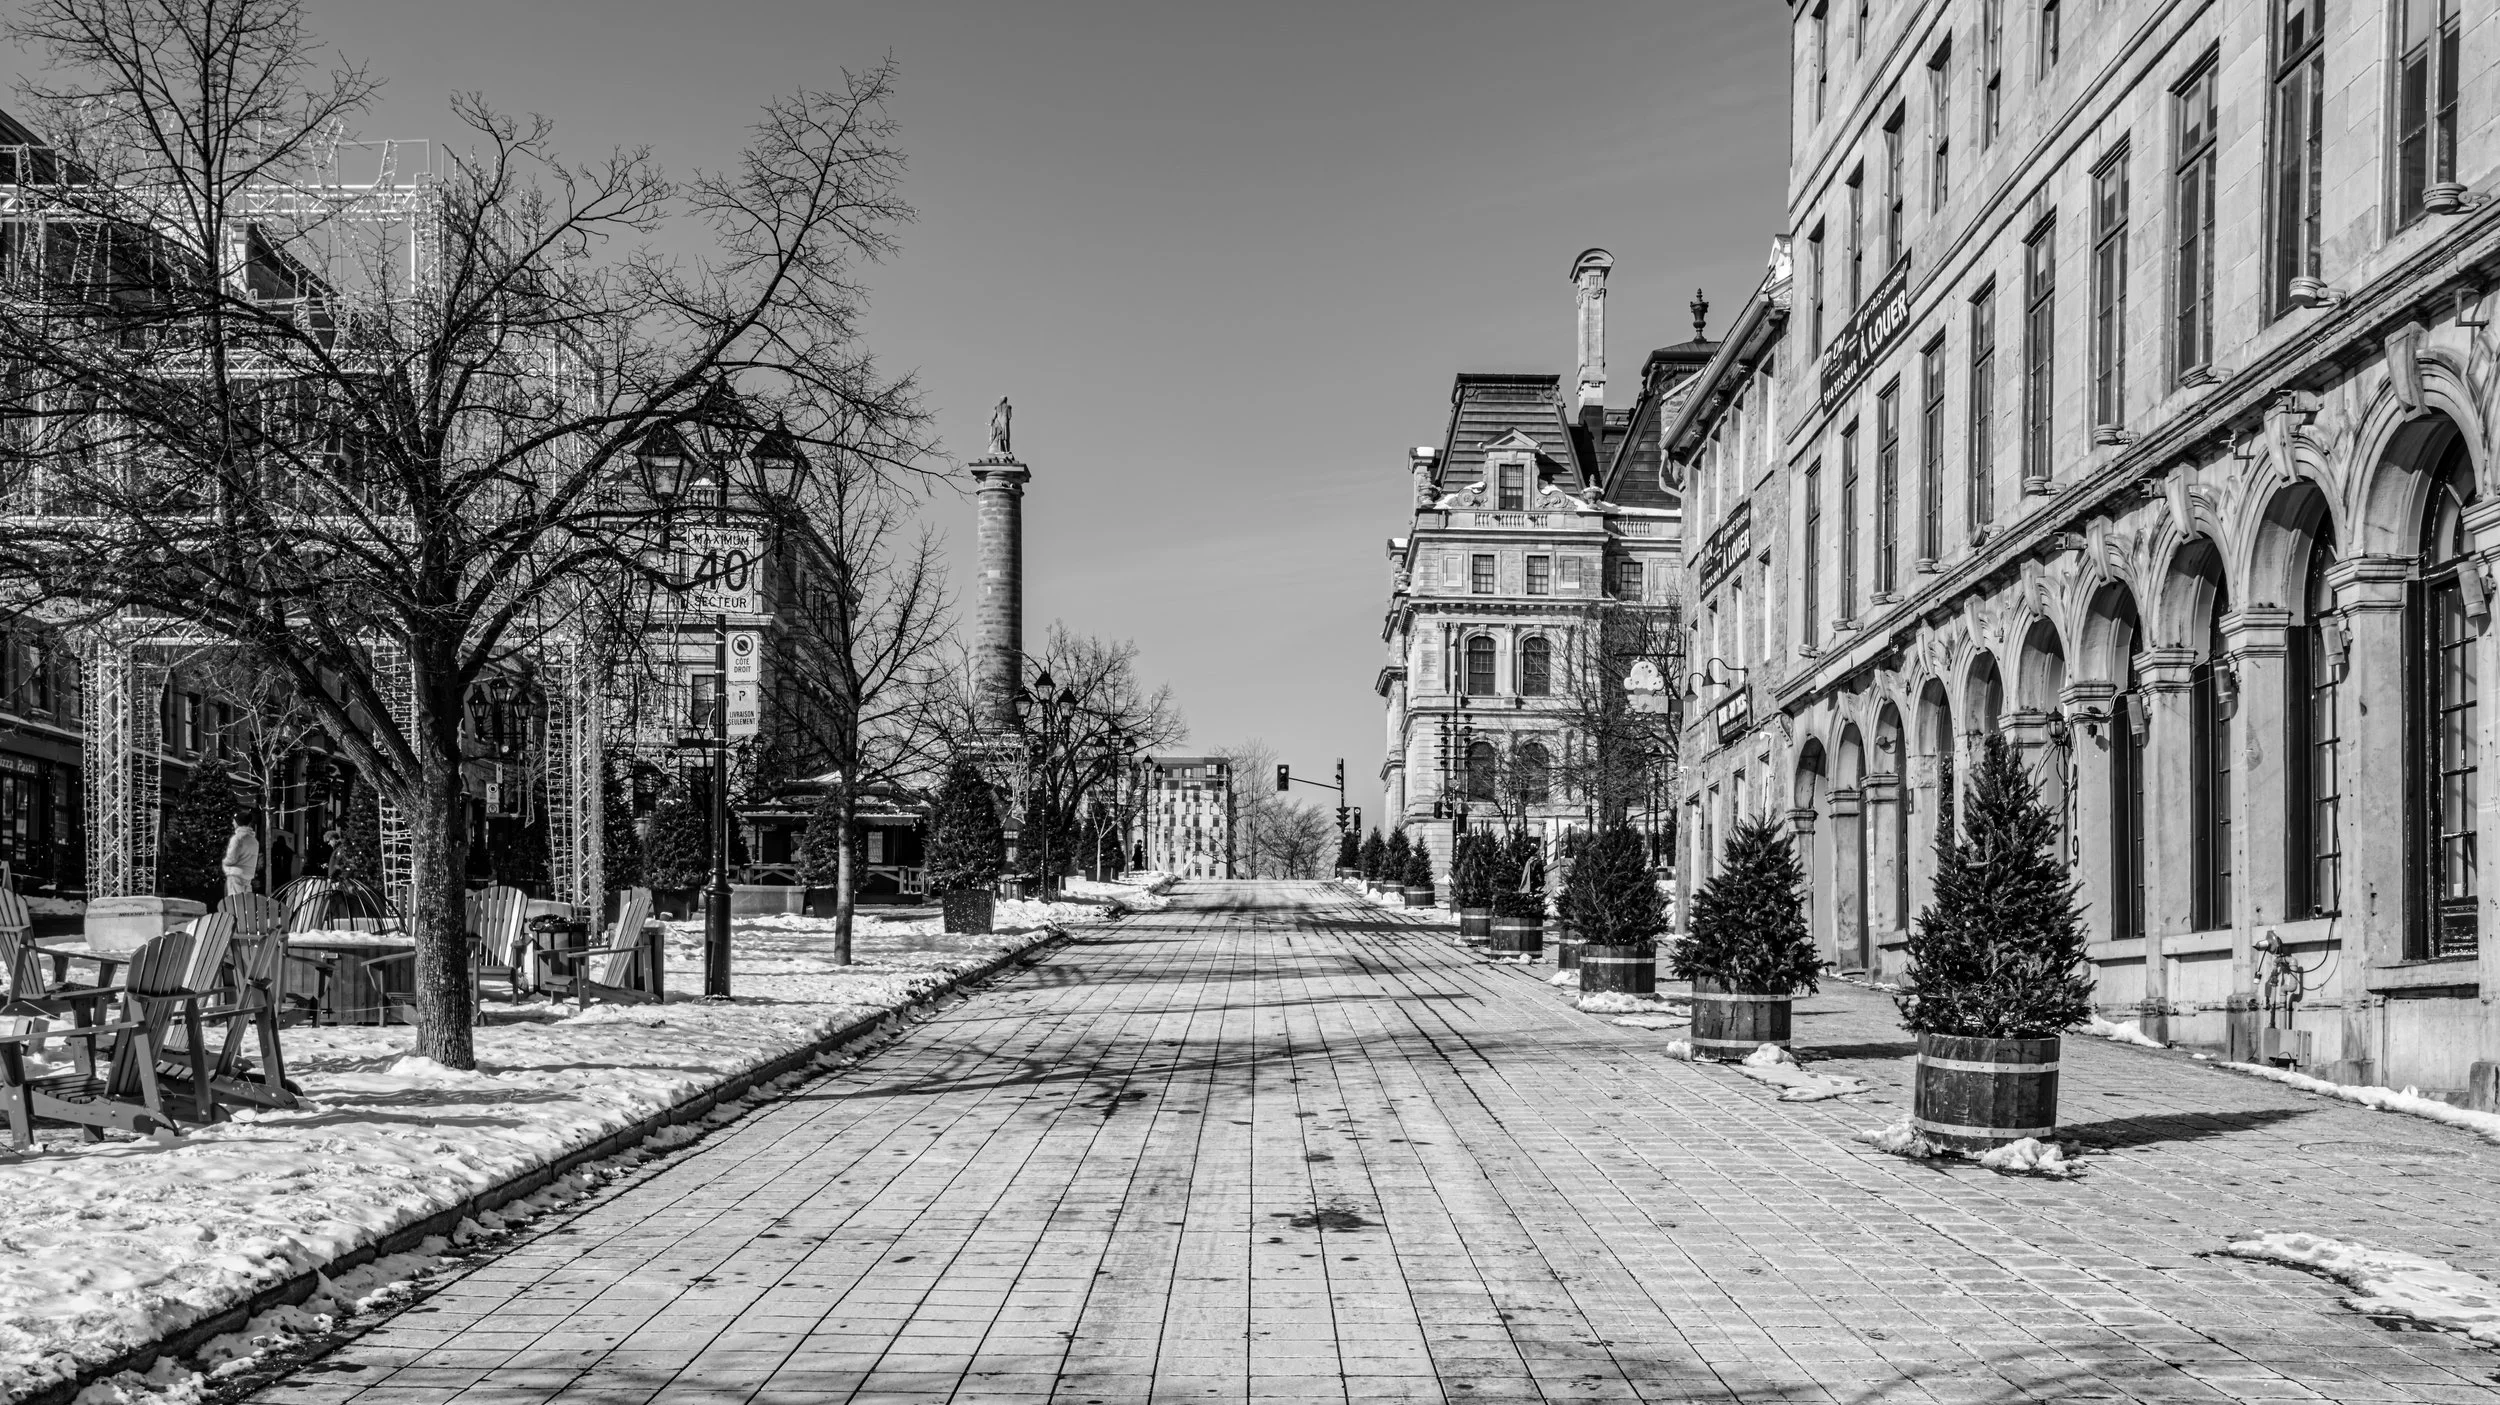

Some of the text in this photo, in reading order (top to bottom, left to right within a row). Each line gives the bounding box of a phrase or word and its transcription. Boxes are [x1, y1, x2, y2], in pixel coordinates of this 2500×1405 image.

[1868, 289, 1907, 353] LOUER
[694, 534, 749, 546] MAXIMUM
[1728, 528, 1750, 567] LOUER
[694, 549, 748, 592] 40
[695, 597, 747, 608] SECTEUR
[733, 665, 751, 673] DROIT
[729, 710, 755, 718] LIVRAISON
[728, 717, 756, 726] SEULEMENT
[17, 759, 36, 774] Pasta
